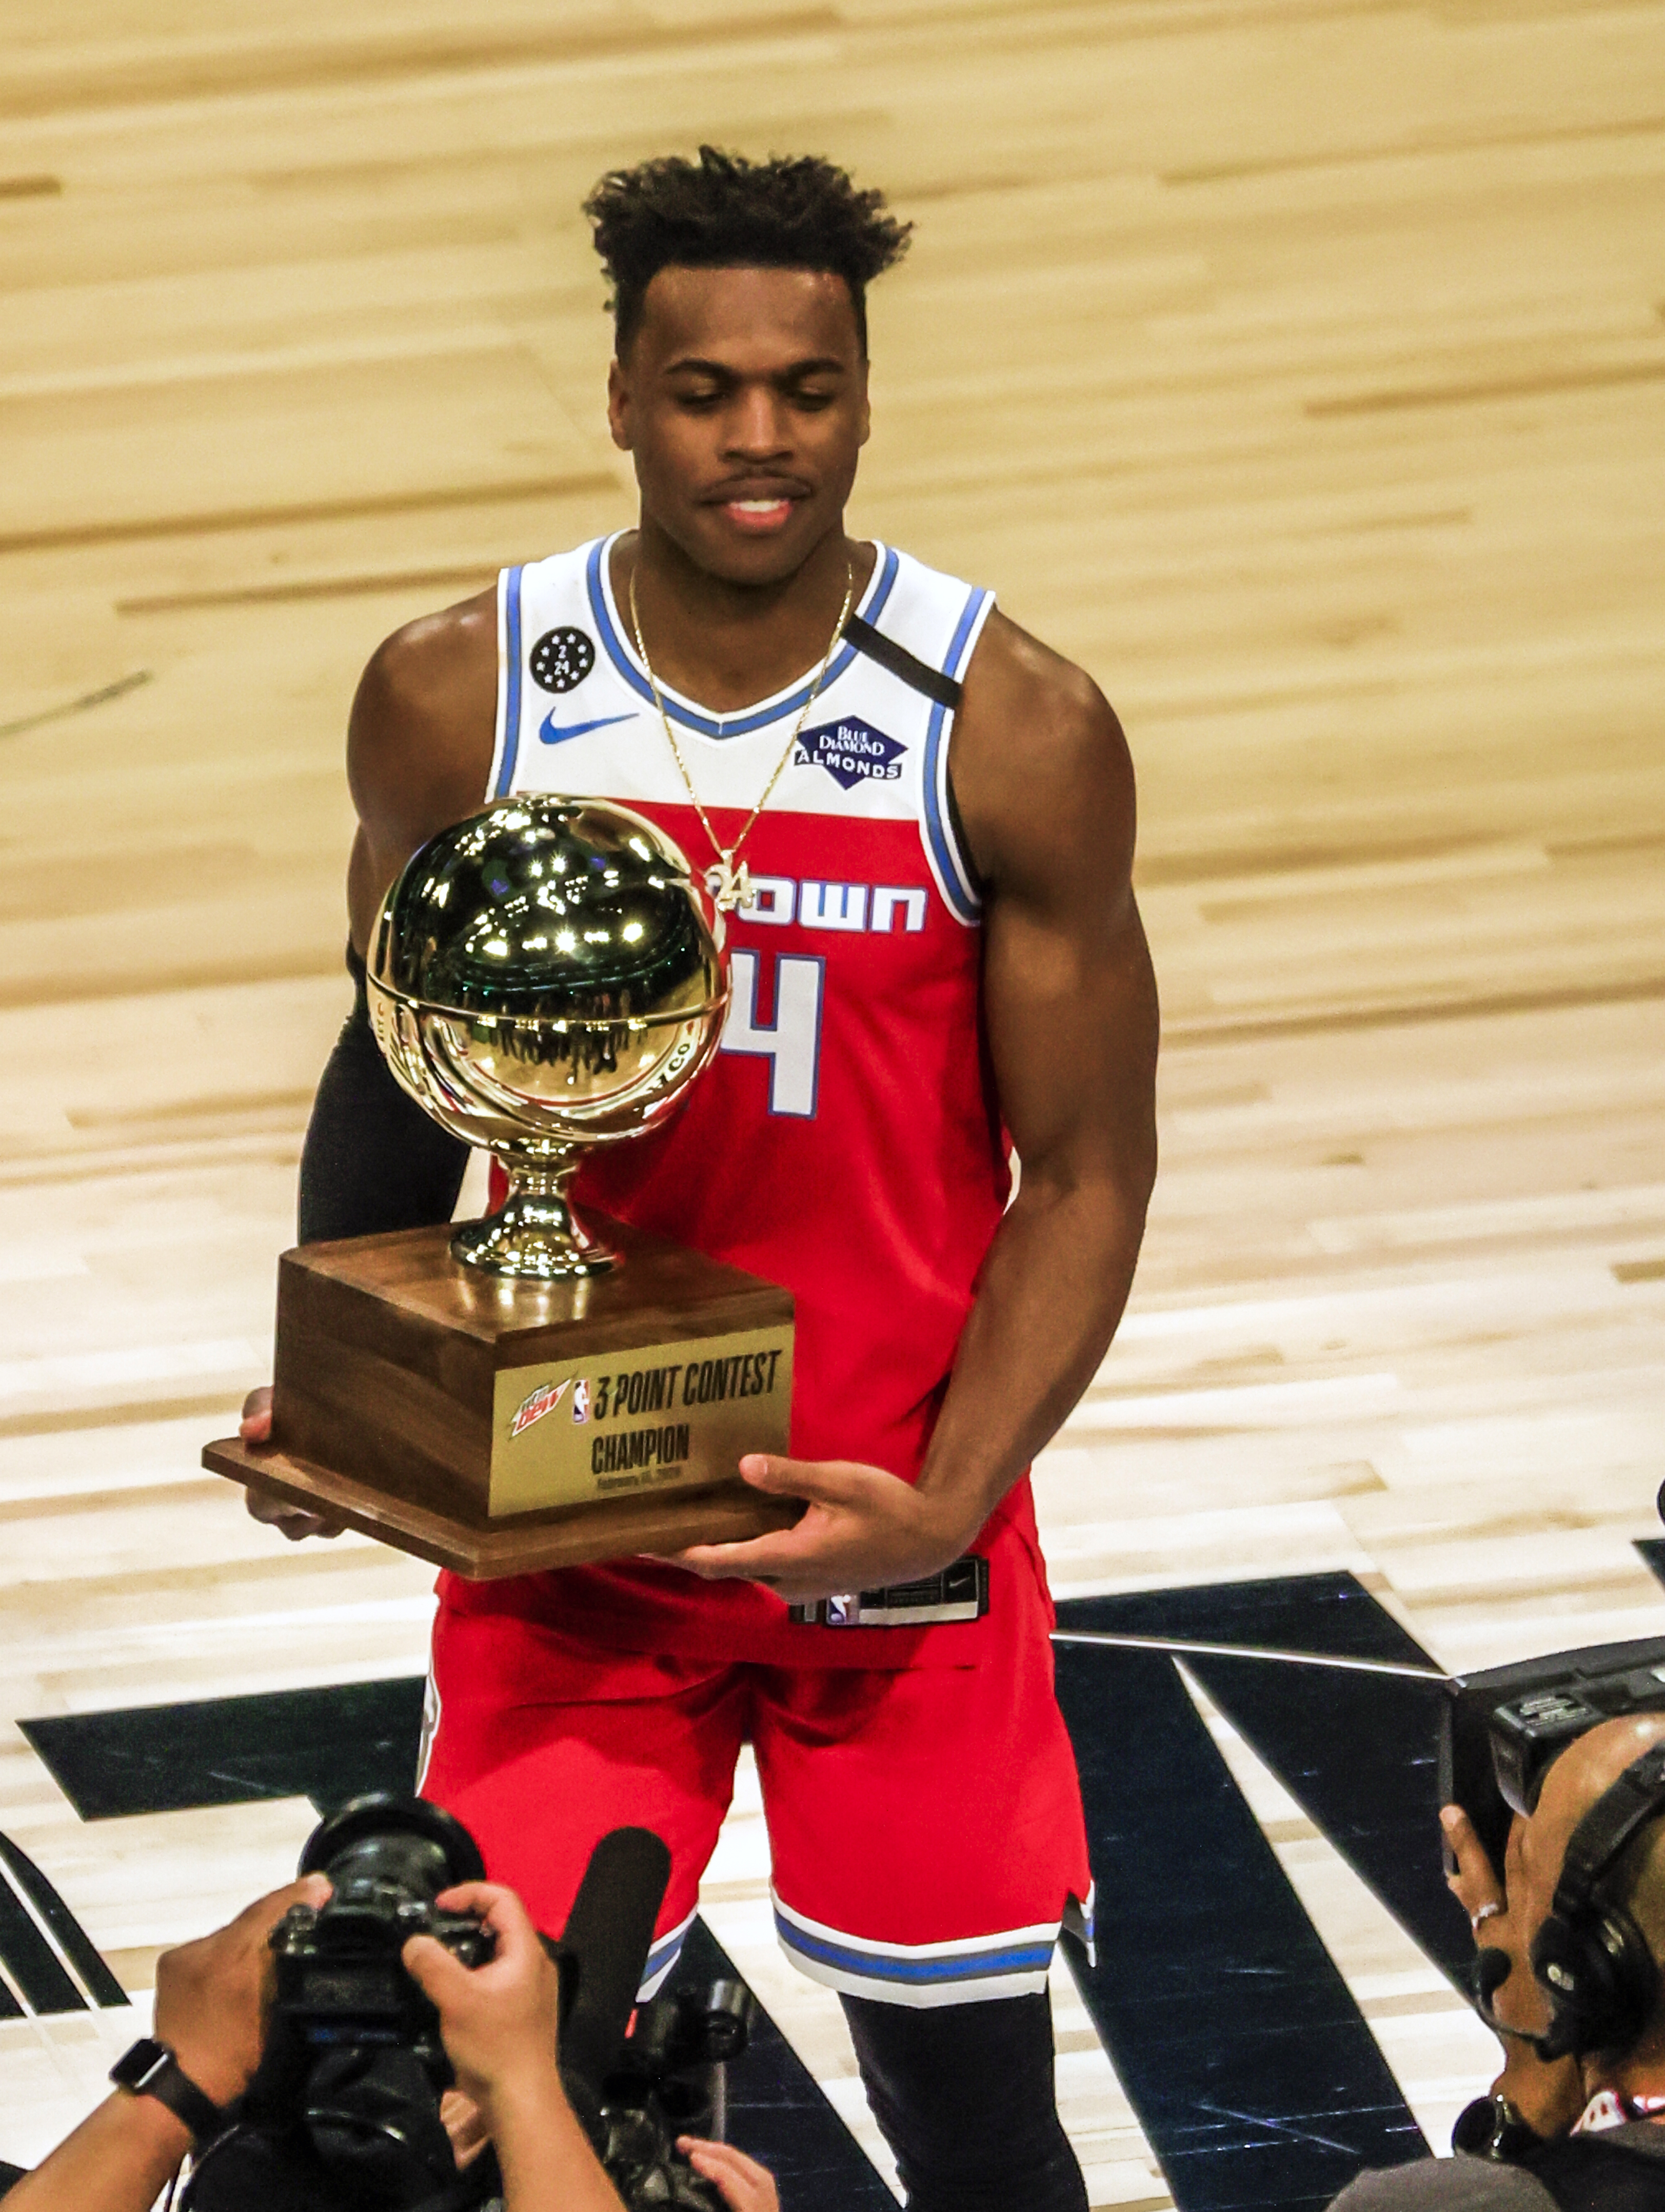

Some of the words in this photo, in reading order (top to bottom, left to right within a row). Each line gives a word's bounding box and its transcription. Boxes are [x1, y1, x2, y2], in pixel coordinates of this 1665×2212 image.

[559, 645, 566, 659] 2
[554, 660, 569, 675] 24
[819, 735, 885, 756] DIAMOND
[798, 749, 898, 779] ALMONDS
[594, 1376, 610, 1419] 3
[613, 1365, 682, 1417] POINT
[682, 1349, 782, 1406] CONTEST
[591, 1423, 689, 1474] CHAMPION
